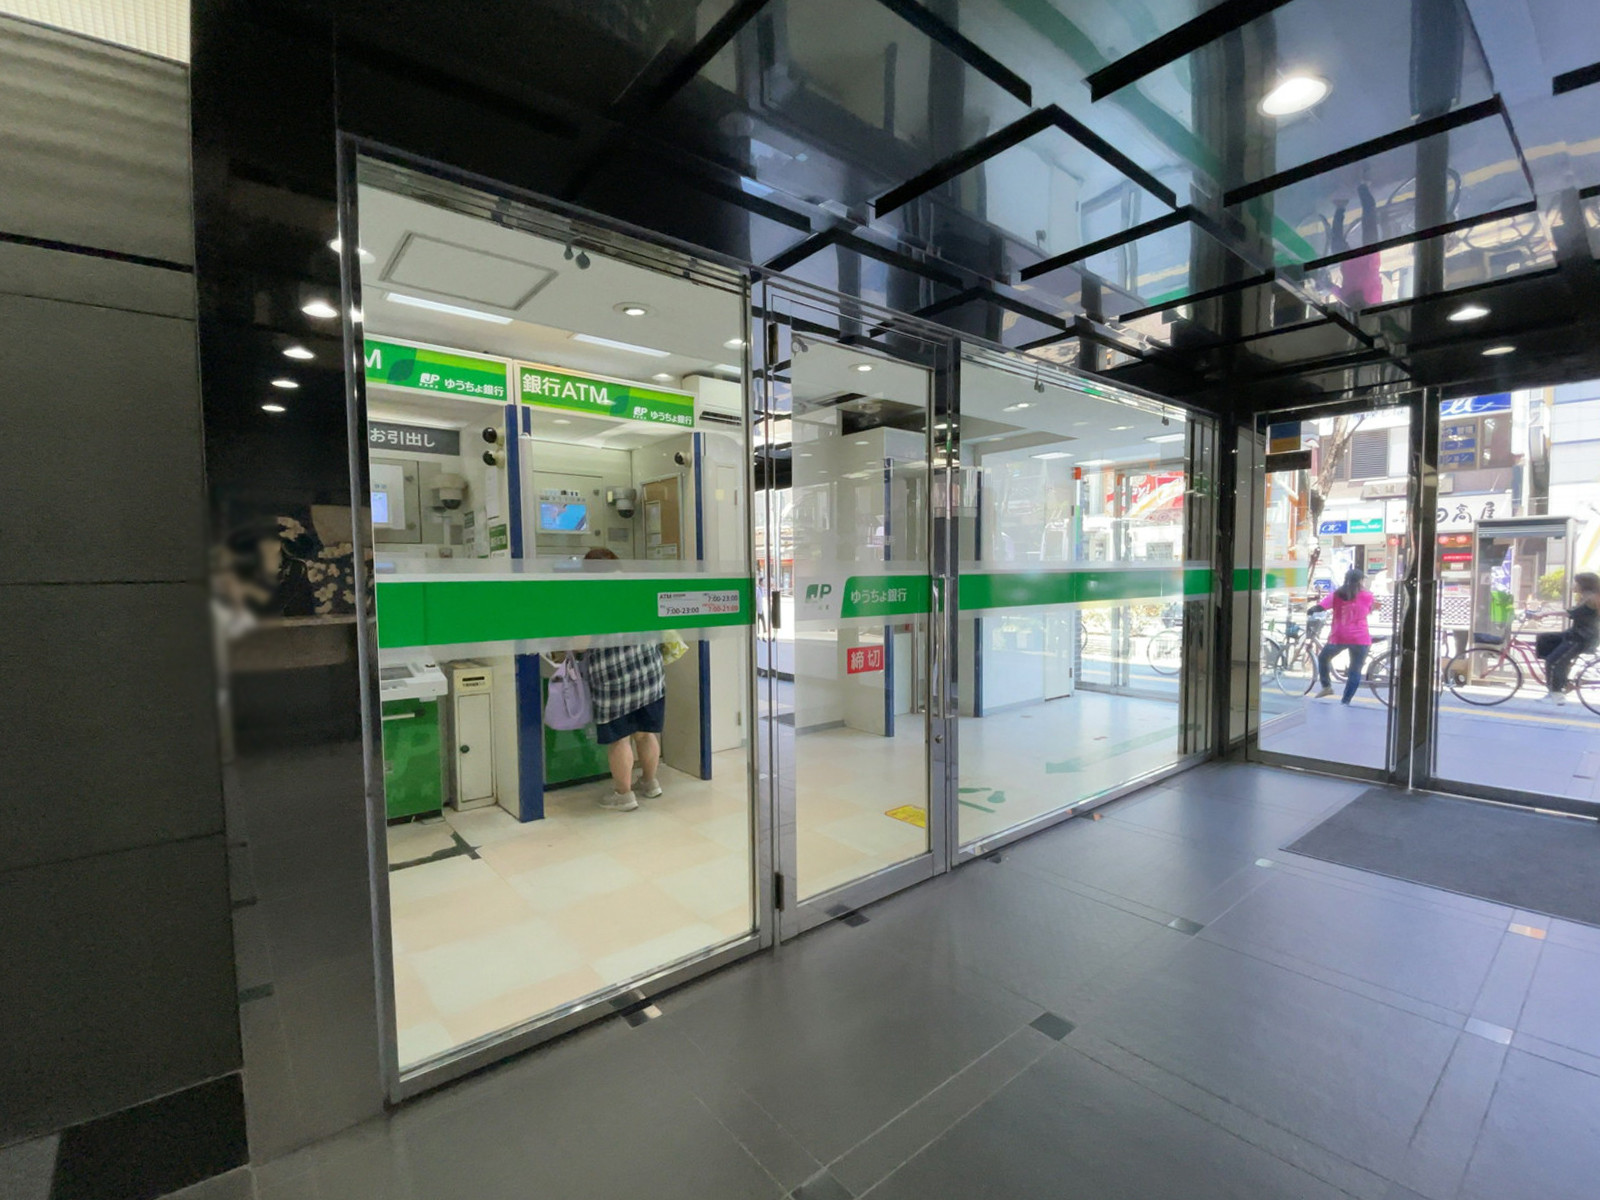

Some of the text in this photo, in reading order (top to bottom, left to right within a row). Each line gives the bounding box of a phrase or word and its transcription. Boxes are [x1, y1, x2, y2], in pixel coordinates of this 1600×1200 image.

[444, 378, 504, 397] ゆうちょ銀行
[522, 373, 609, 404] 銀行ATM
[650, 411, 692, 425] ゆうちょ銀行
[370, 428, 436, 448] お引出し
[707, 594, 738, 602] 7:00-23:00
[850, 588, 908, 604] ゆうちょ銀行
[666, 606, 699, 614] 7:00-23:00
[850, 649, 881, 670] 締切
